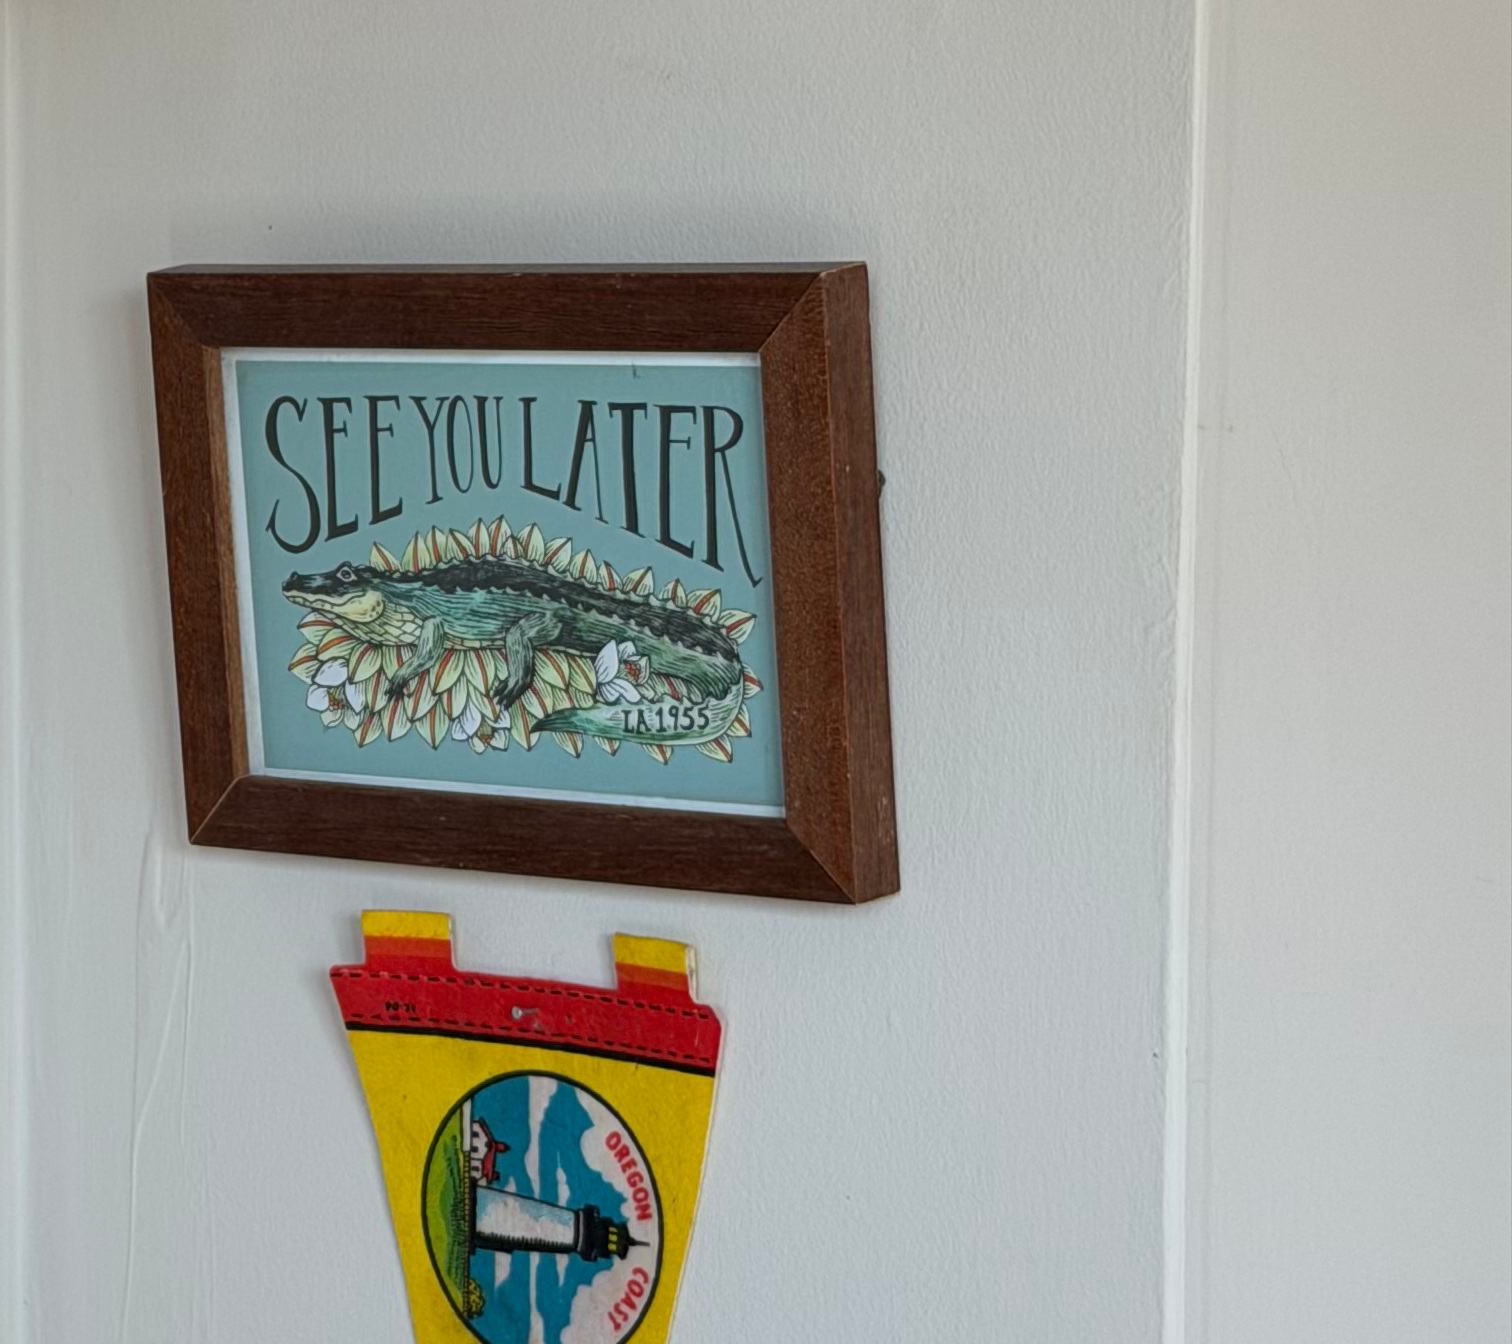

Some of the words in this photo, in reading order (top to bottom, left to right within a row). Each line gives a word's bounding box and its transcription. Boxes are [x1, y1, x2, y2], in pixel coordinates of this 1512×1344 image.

[264, 394, 403, 554] SEE
[408, 394, 504, 505] YOU
[519, 396, 763, 588] LATER
[621, 708, 651, 734] LA
[654, 704, 710, 733] 1955
[604, 1130, 653, 1222] OREGON
[607, 1266, 650, 1332] COAST
